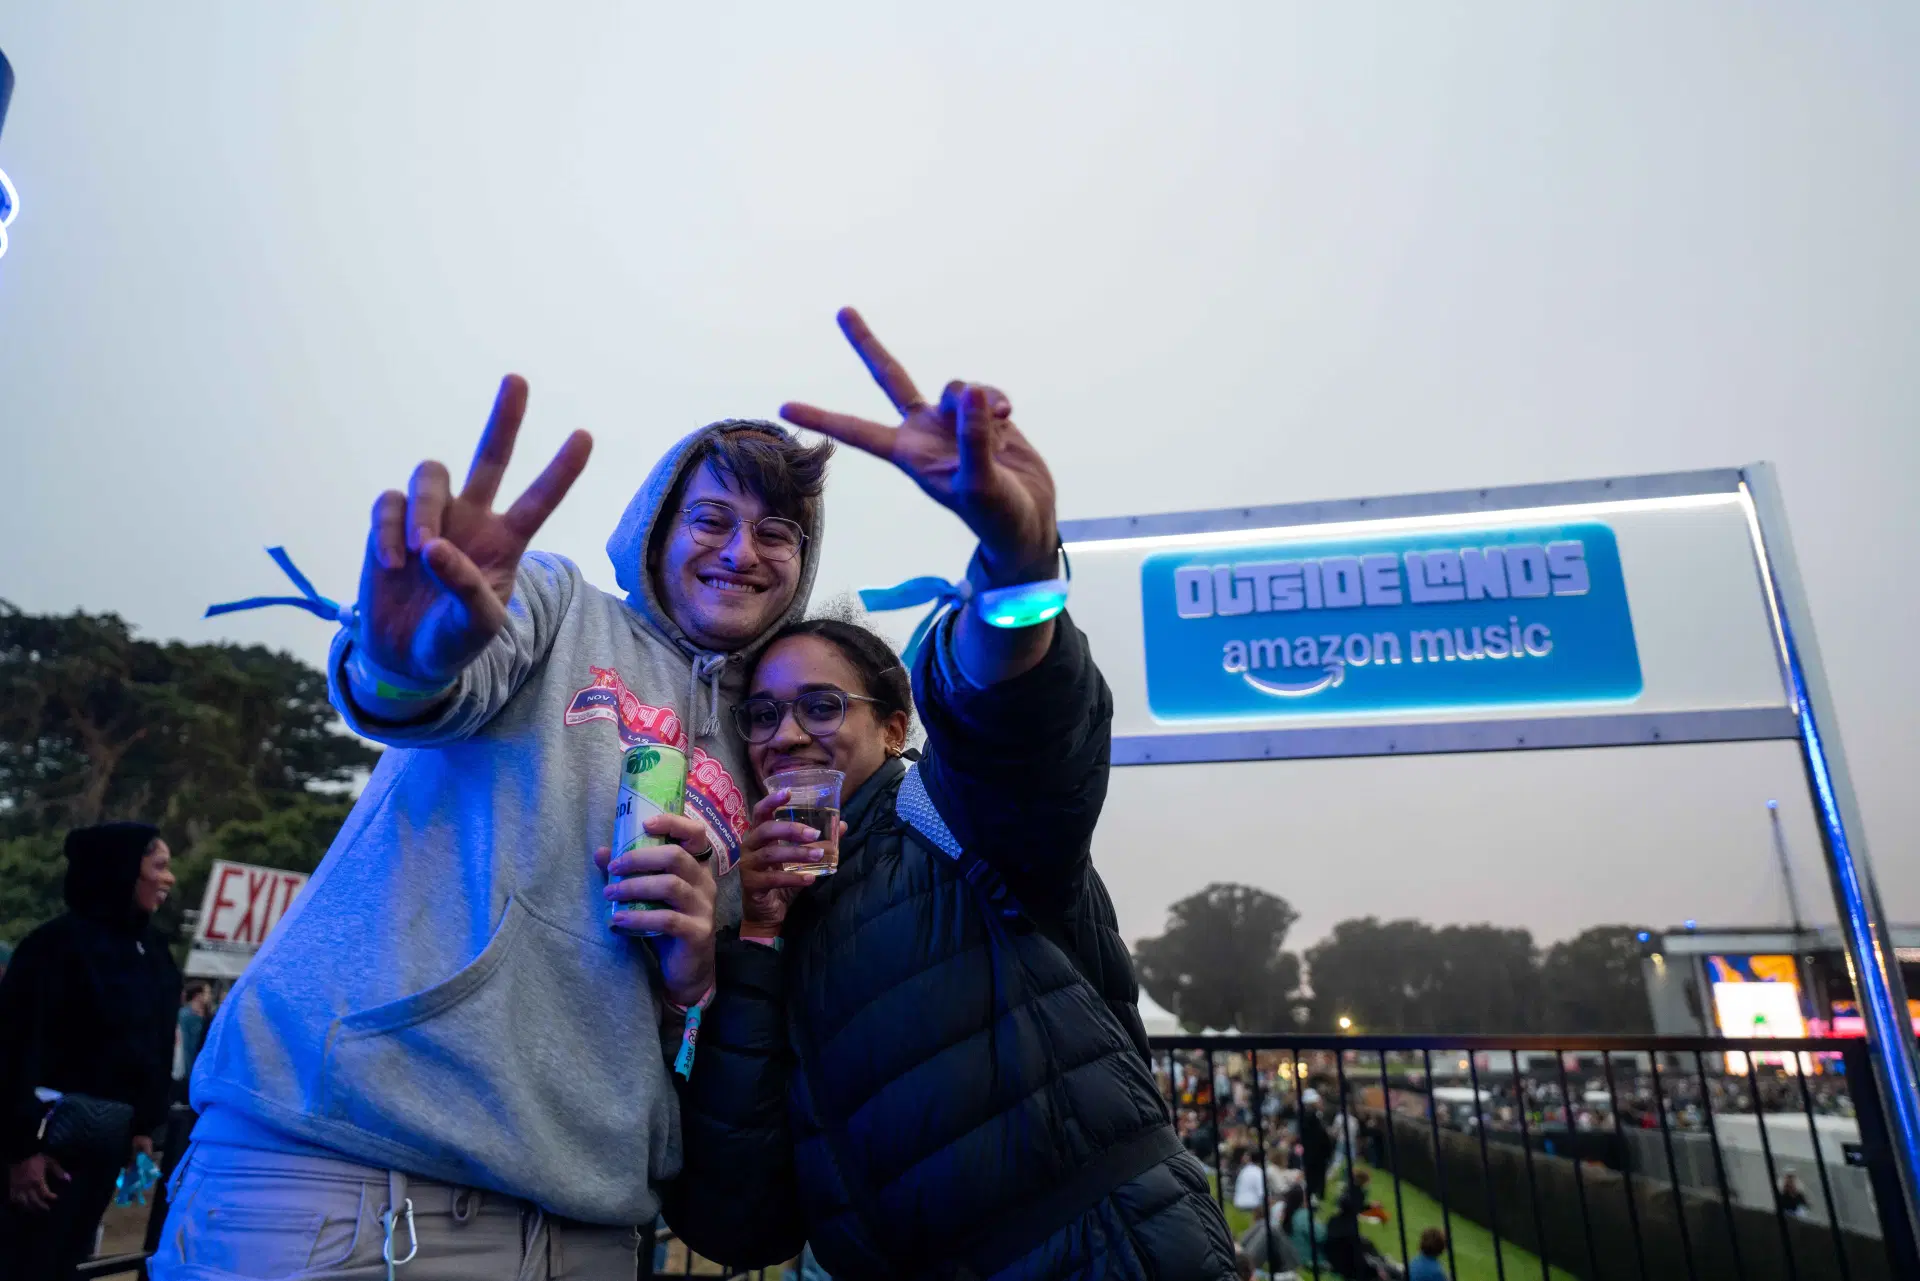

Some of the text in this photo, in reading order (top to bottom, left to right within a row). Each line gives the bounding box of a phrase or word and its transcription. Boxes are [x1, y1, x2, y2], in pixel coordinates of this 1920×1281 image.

[1174, 539, 1591, 619] OUTSIDE LANDS
[1222, 616, 1553, 673] amazon music
[586, 694, 611, 702] NOV
[627, 734, 650, 744] LAS
[705, 806, 737, 849] GROUNDS
[205, 868, 300, 943] EXIT
